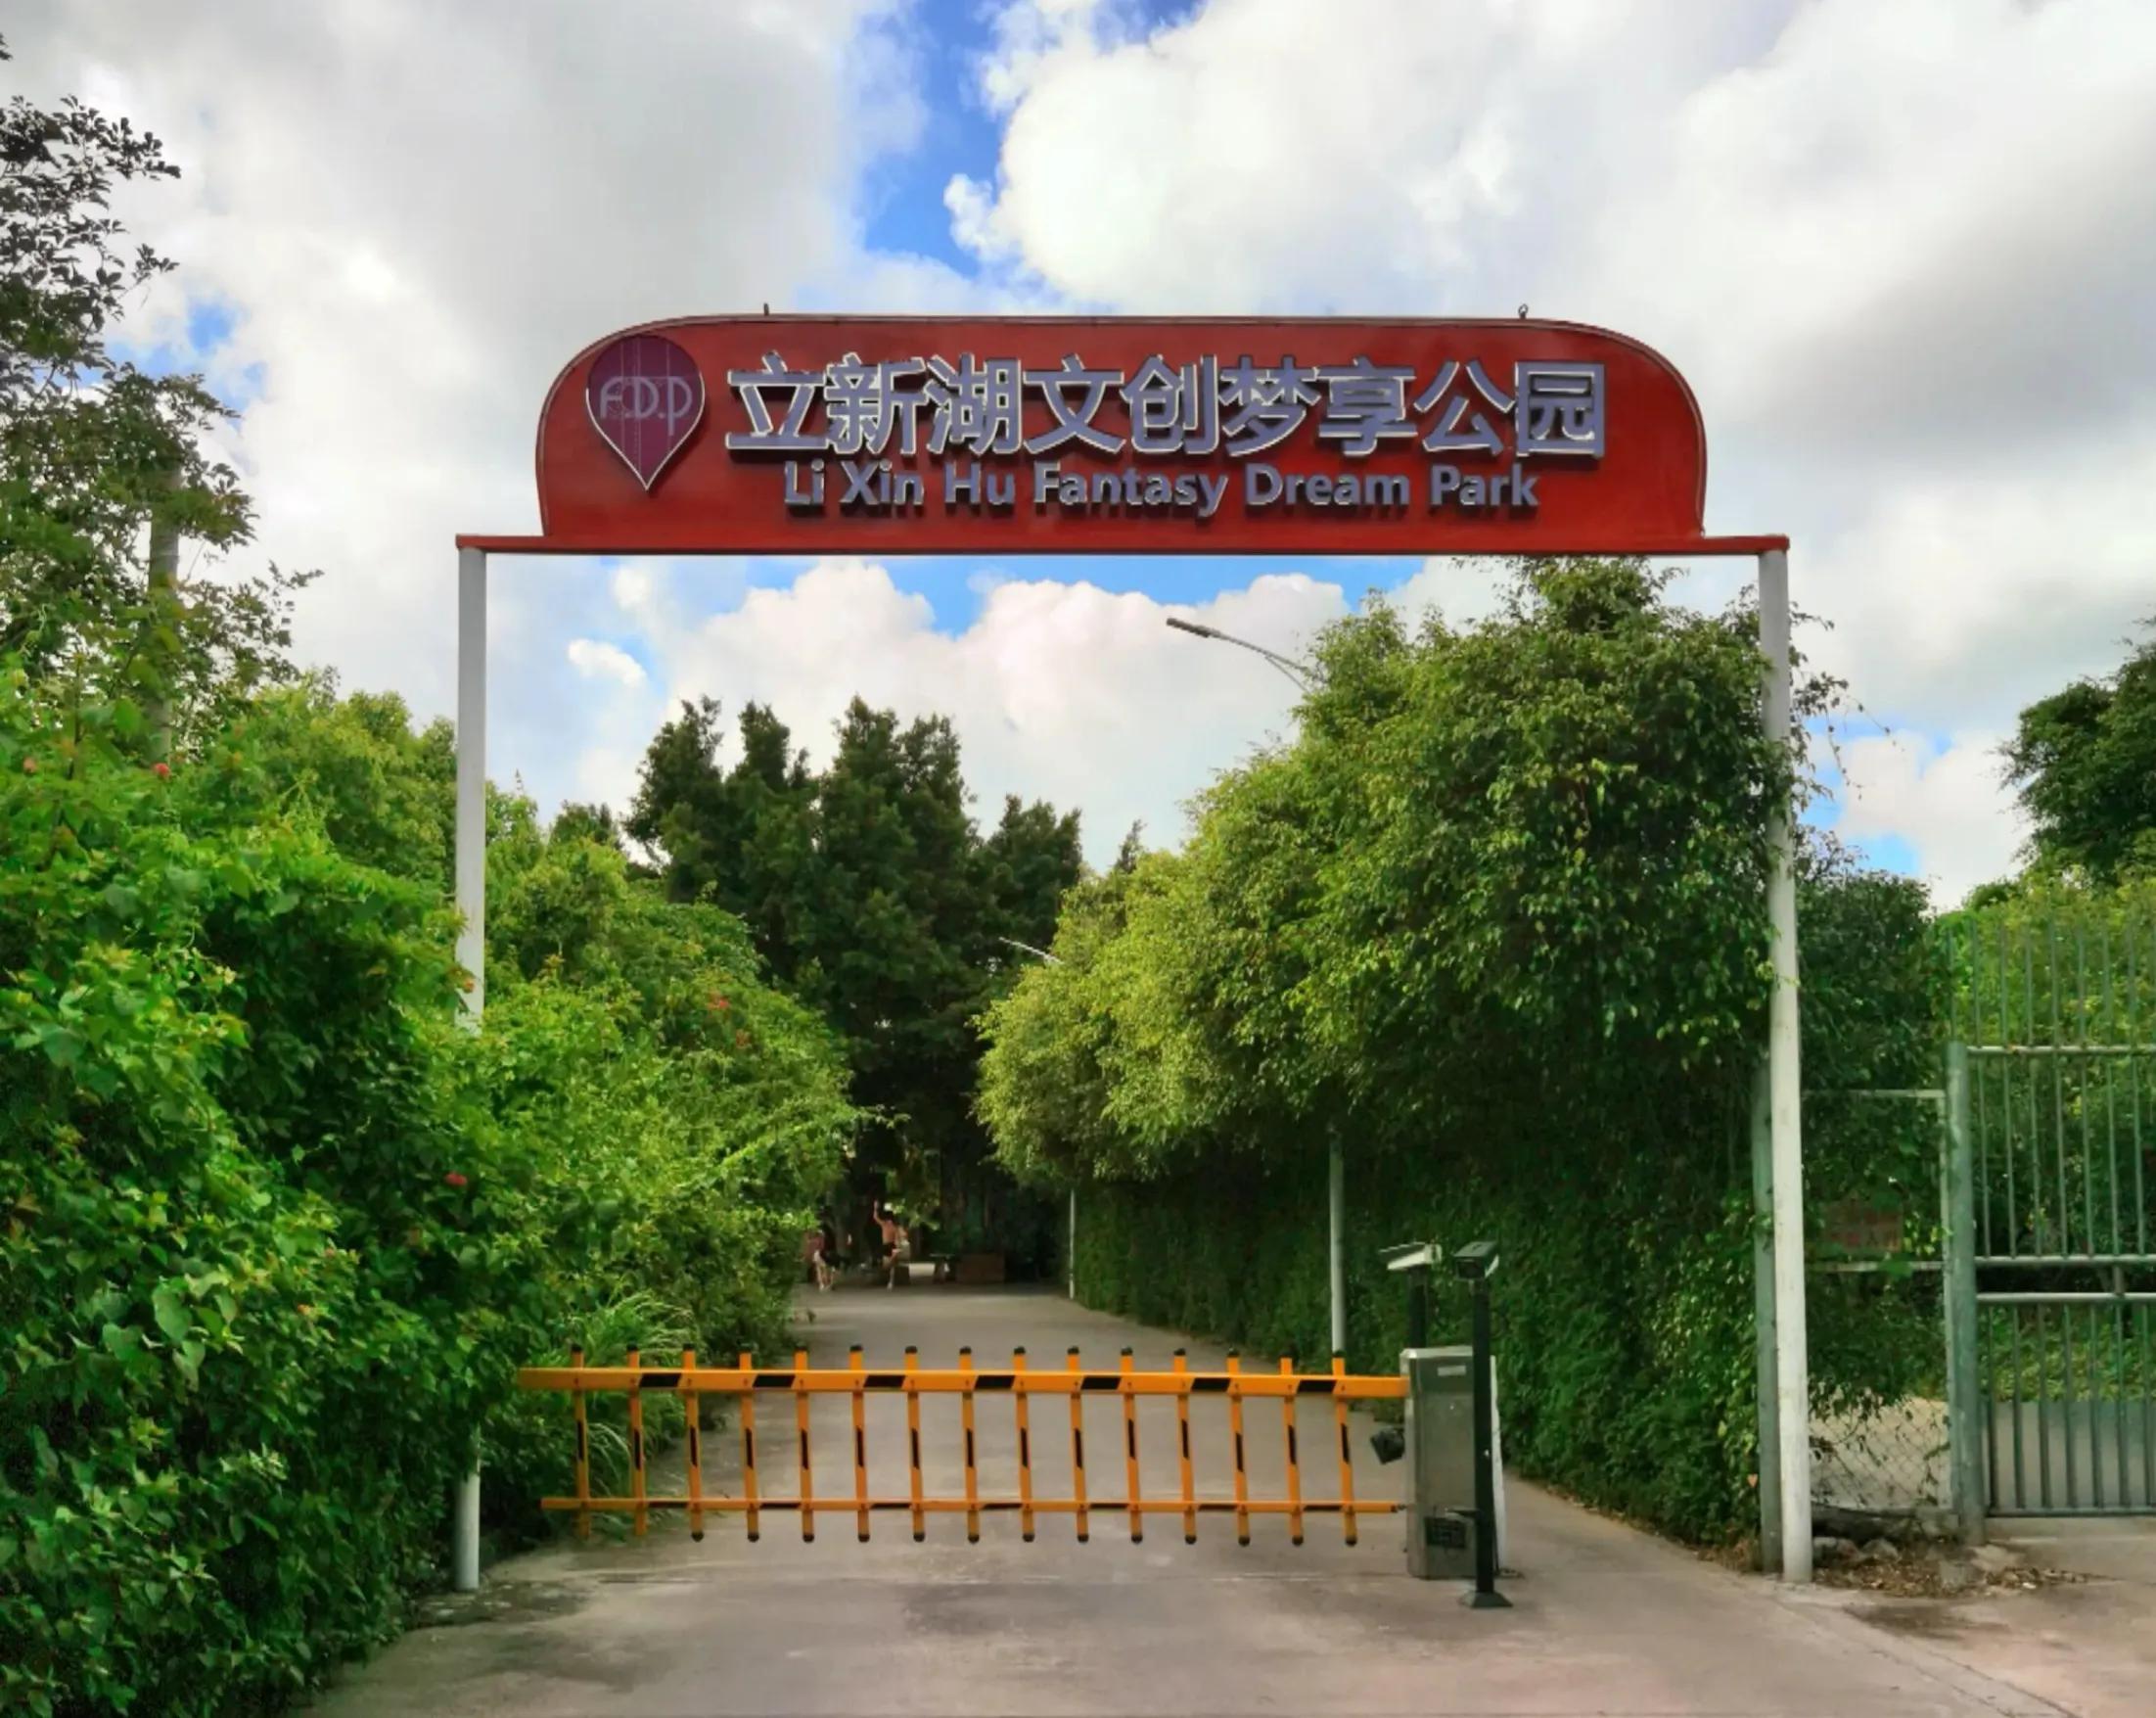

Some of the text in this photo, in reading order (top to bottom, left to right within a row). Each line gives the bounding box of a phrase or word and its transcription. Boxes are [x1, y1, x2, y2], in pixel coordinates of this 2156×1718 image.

[725, 350, 1605, 459] 立新湖文创梦享公园
[784, 459, 1539, 518] Li Xin Hu Fantasy Dream Park
